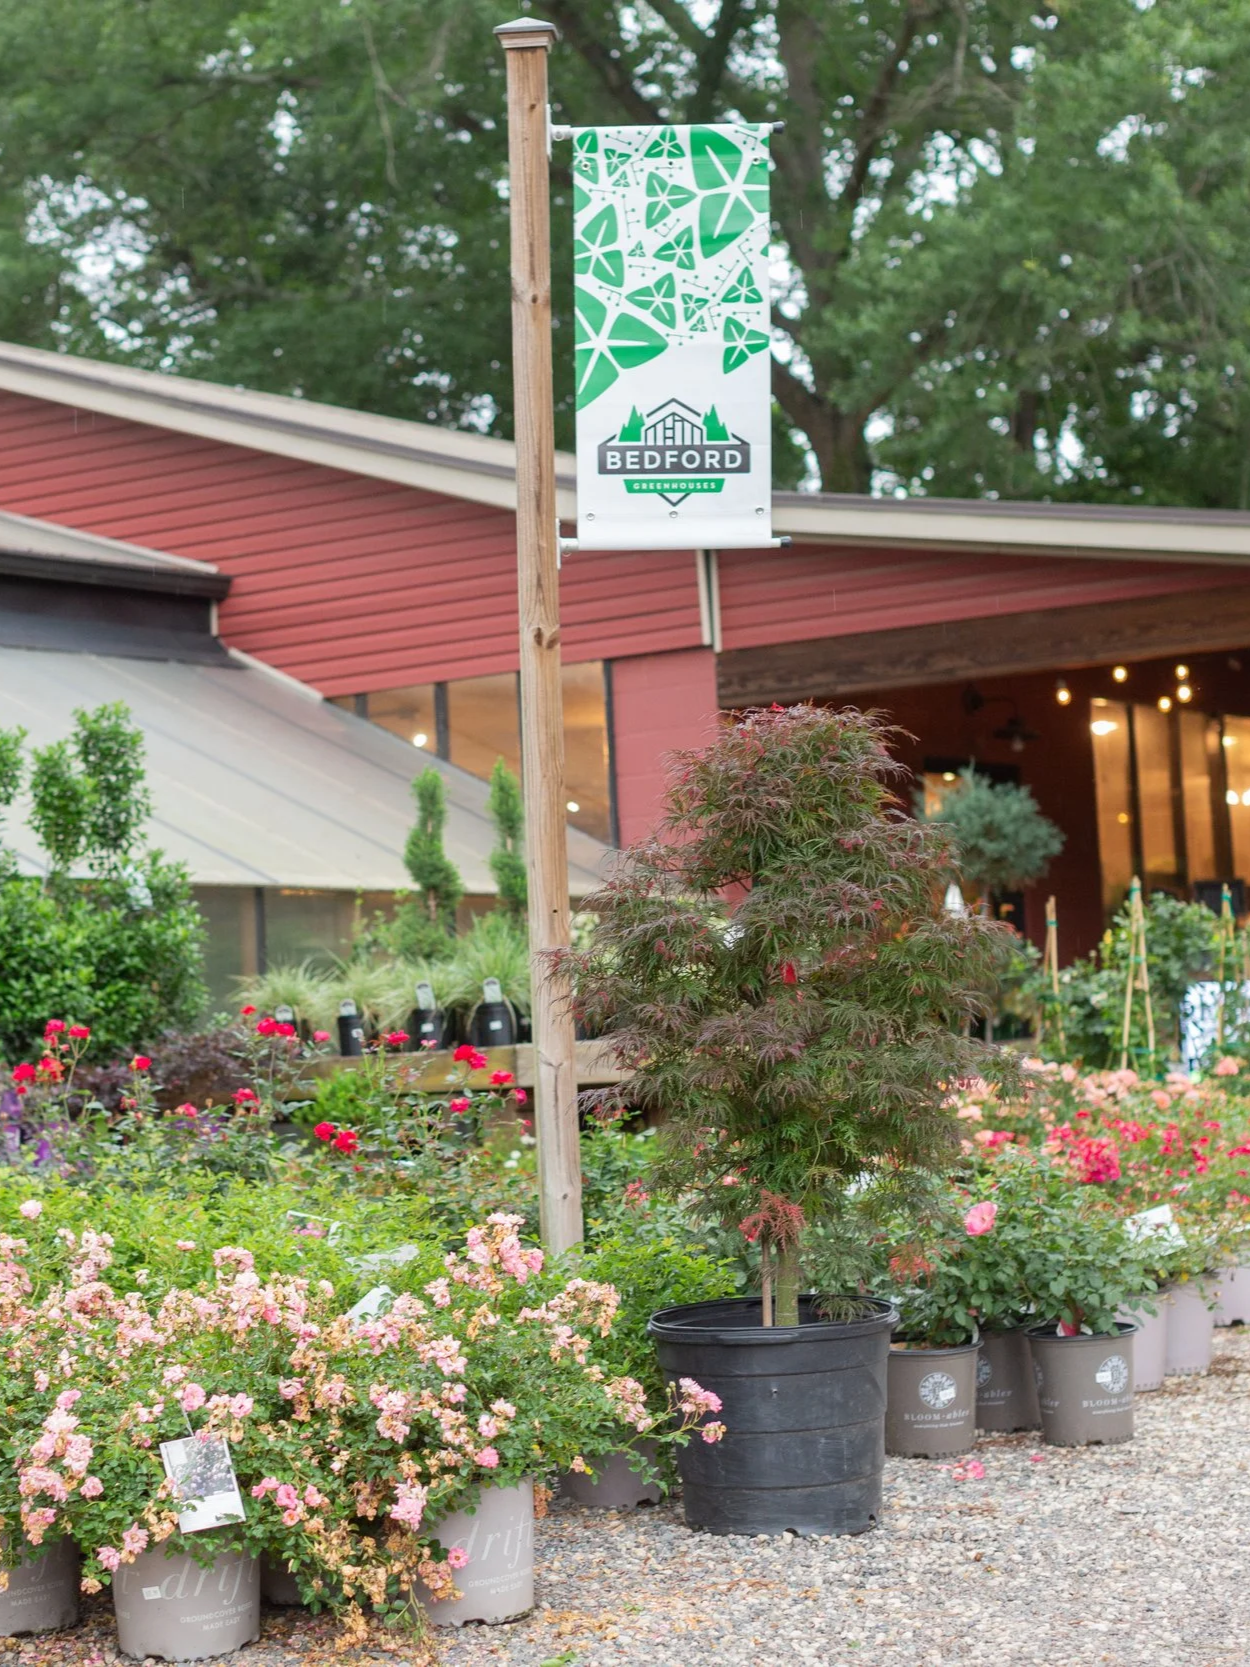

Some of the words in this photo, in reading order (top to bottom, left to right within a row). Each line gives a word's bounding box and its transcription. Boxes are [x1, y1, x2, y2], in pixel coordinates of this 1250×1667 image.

[606, 450, 742, 469] BEDFORD
[633, 481, 716, 490] GREENHOUSES
[450, 1508, 533, 1569] drift
[160, 1554, 255, 1606] drift
[11, 1598, 32, 1606] MADE
[179, 1607, 237, 1624] GROUNDCOVER
[202, 1621, 224, 1632] MADE
[225, 1616, 241, 1627] EASY
